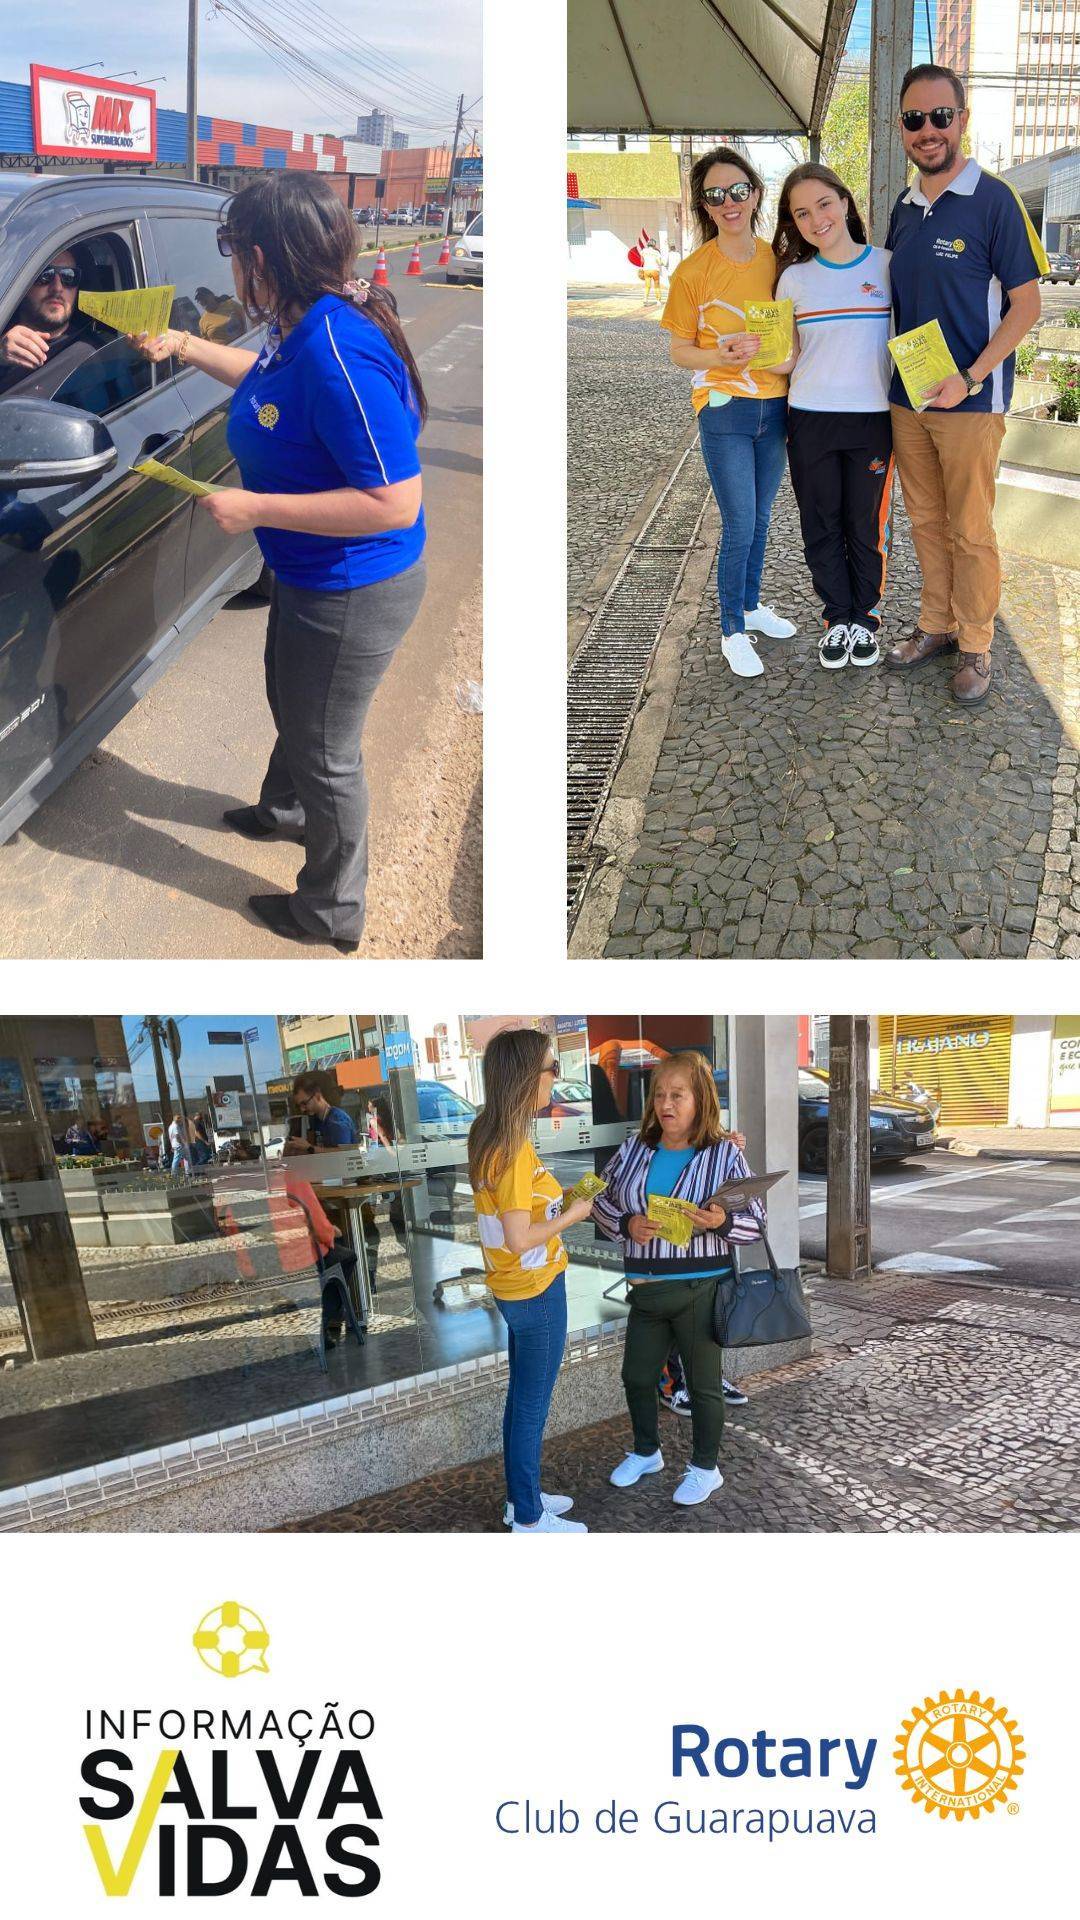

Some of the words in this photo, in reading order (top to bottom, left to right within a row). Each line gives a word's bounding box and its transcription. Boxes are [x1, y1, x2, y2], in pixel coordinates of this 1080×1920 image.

[91, 95, 134, 134] MIX
[91, 134, 134, 148] SUPERMERCADOS
[897, 1030, 990, 1055] TRAJANO
